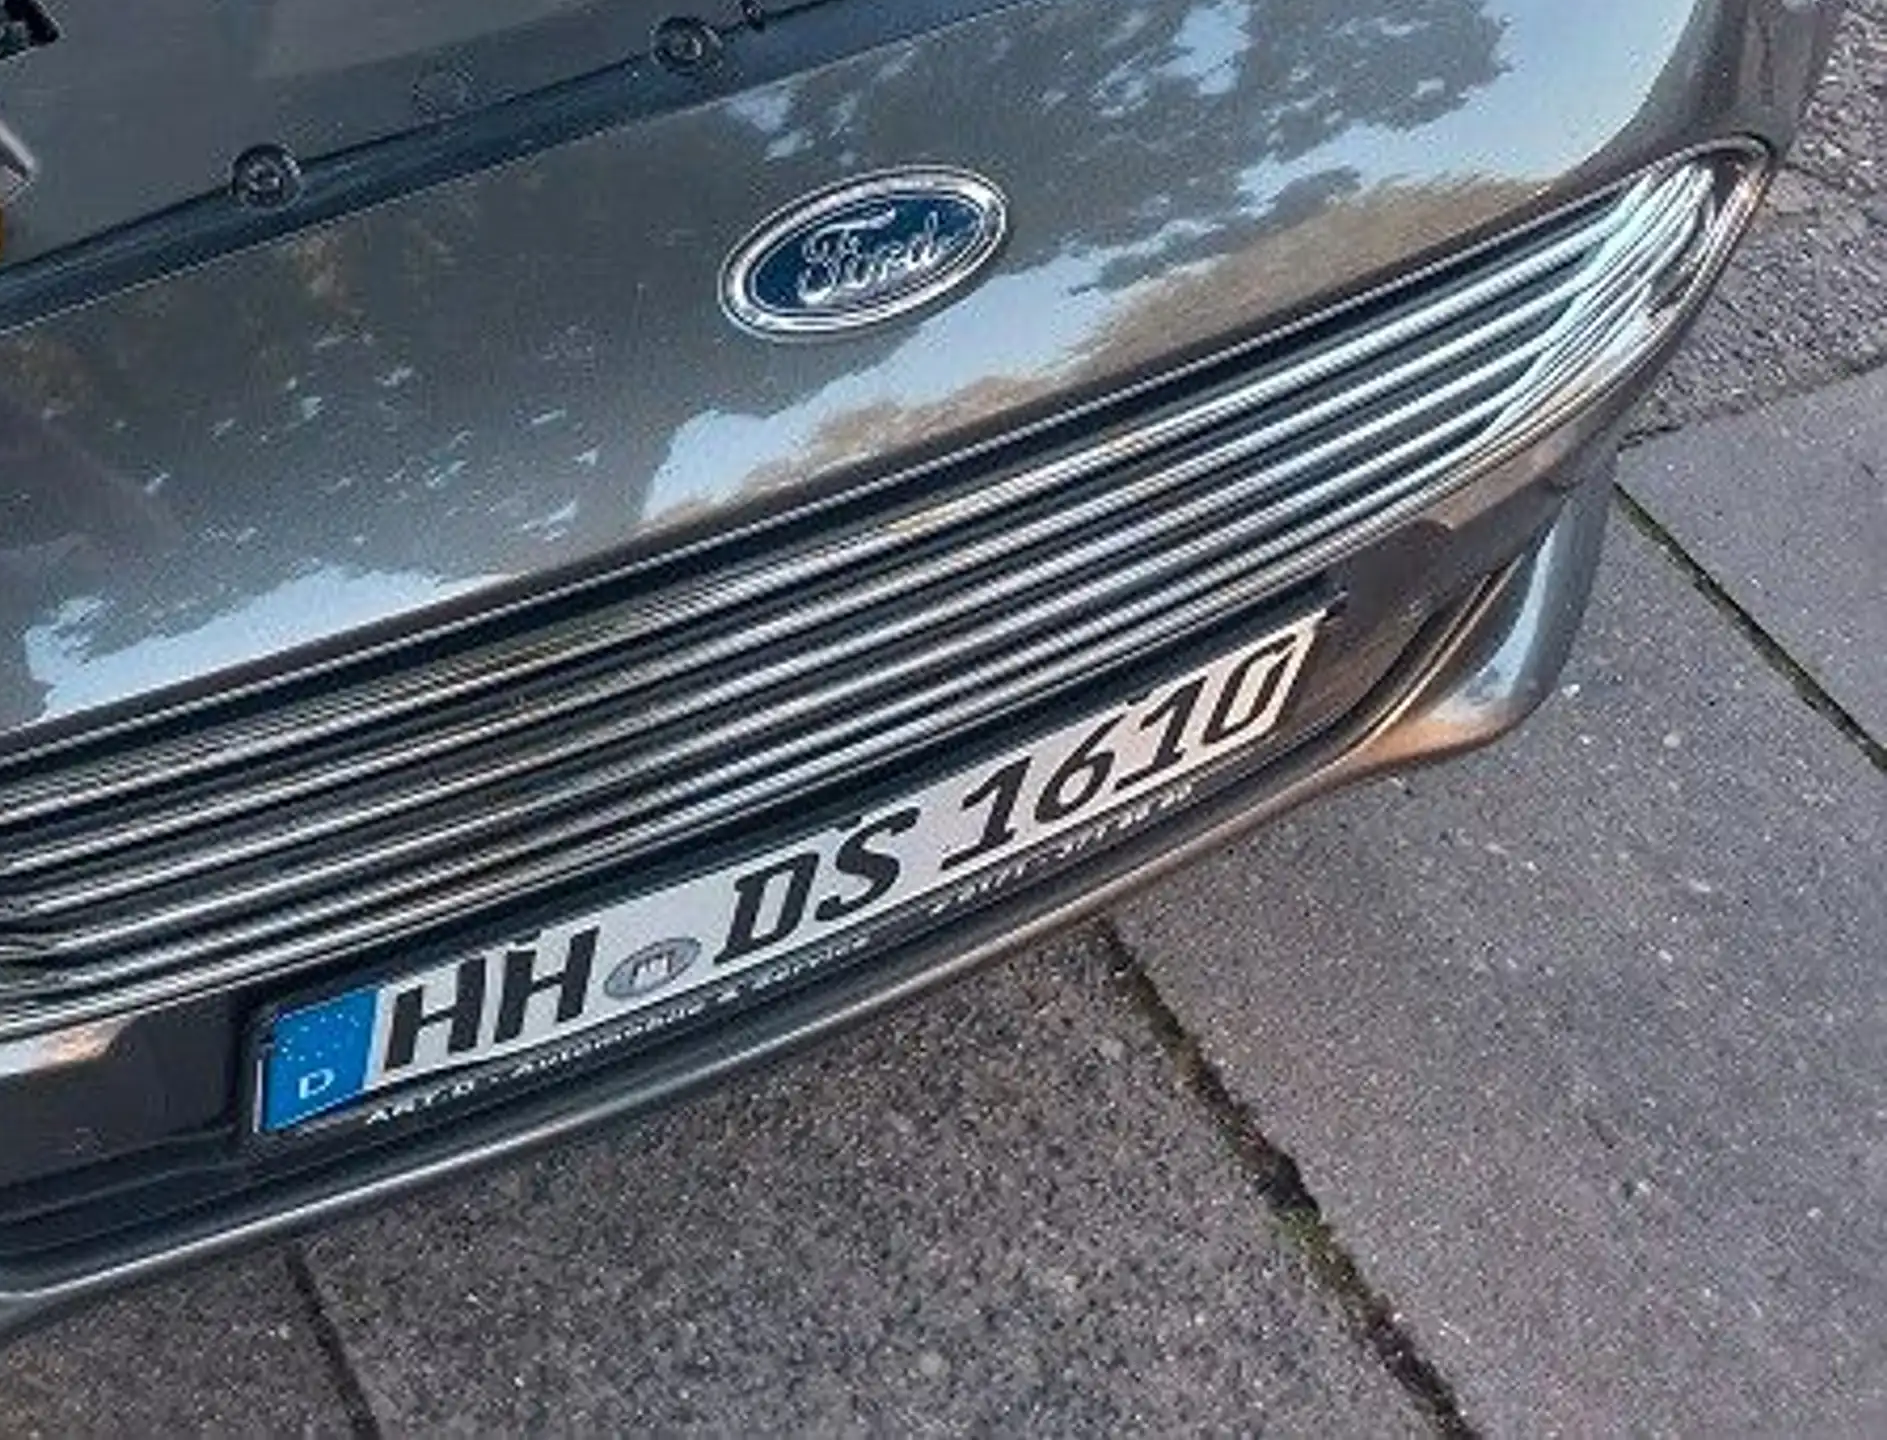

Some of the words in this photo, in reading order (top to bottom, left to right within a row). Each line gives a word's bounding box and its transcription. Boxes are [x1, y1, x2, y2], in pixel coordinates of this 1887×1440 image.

[795, 208, 942, 306] Ford
[384, 925, 600, 1071] HH
[712, 806, 921, 964] DS
[941, 631, 1299, 872] 1610
[298, 1067, 336, 1100] D
